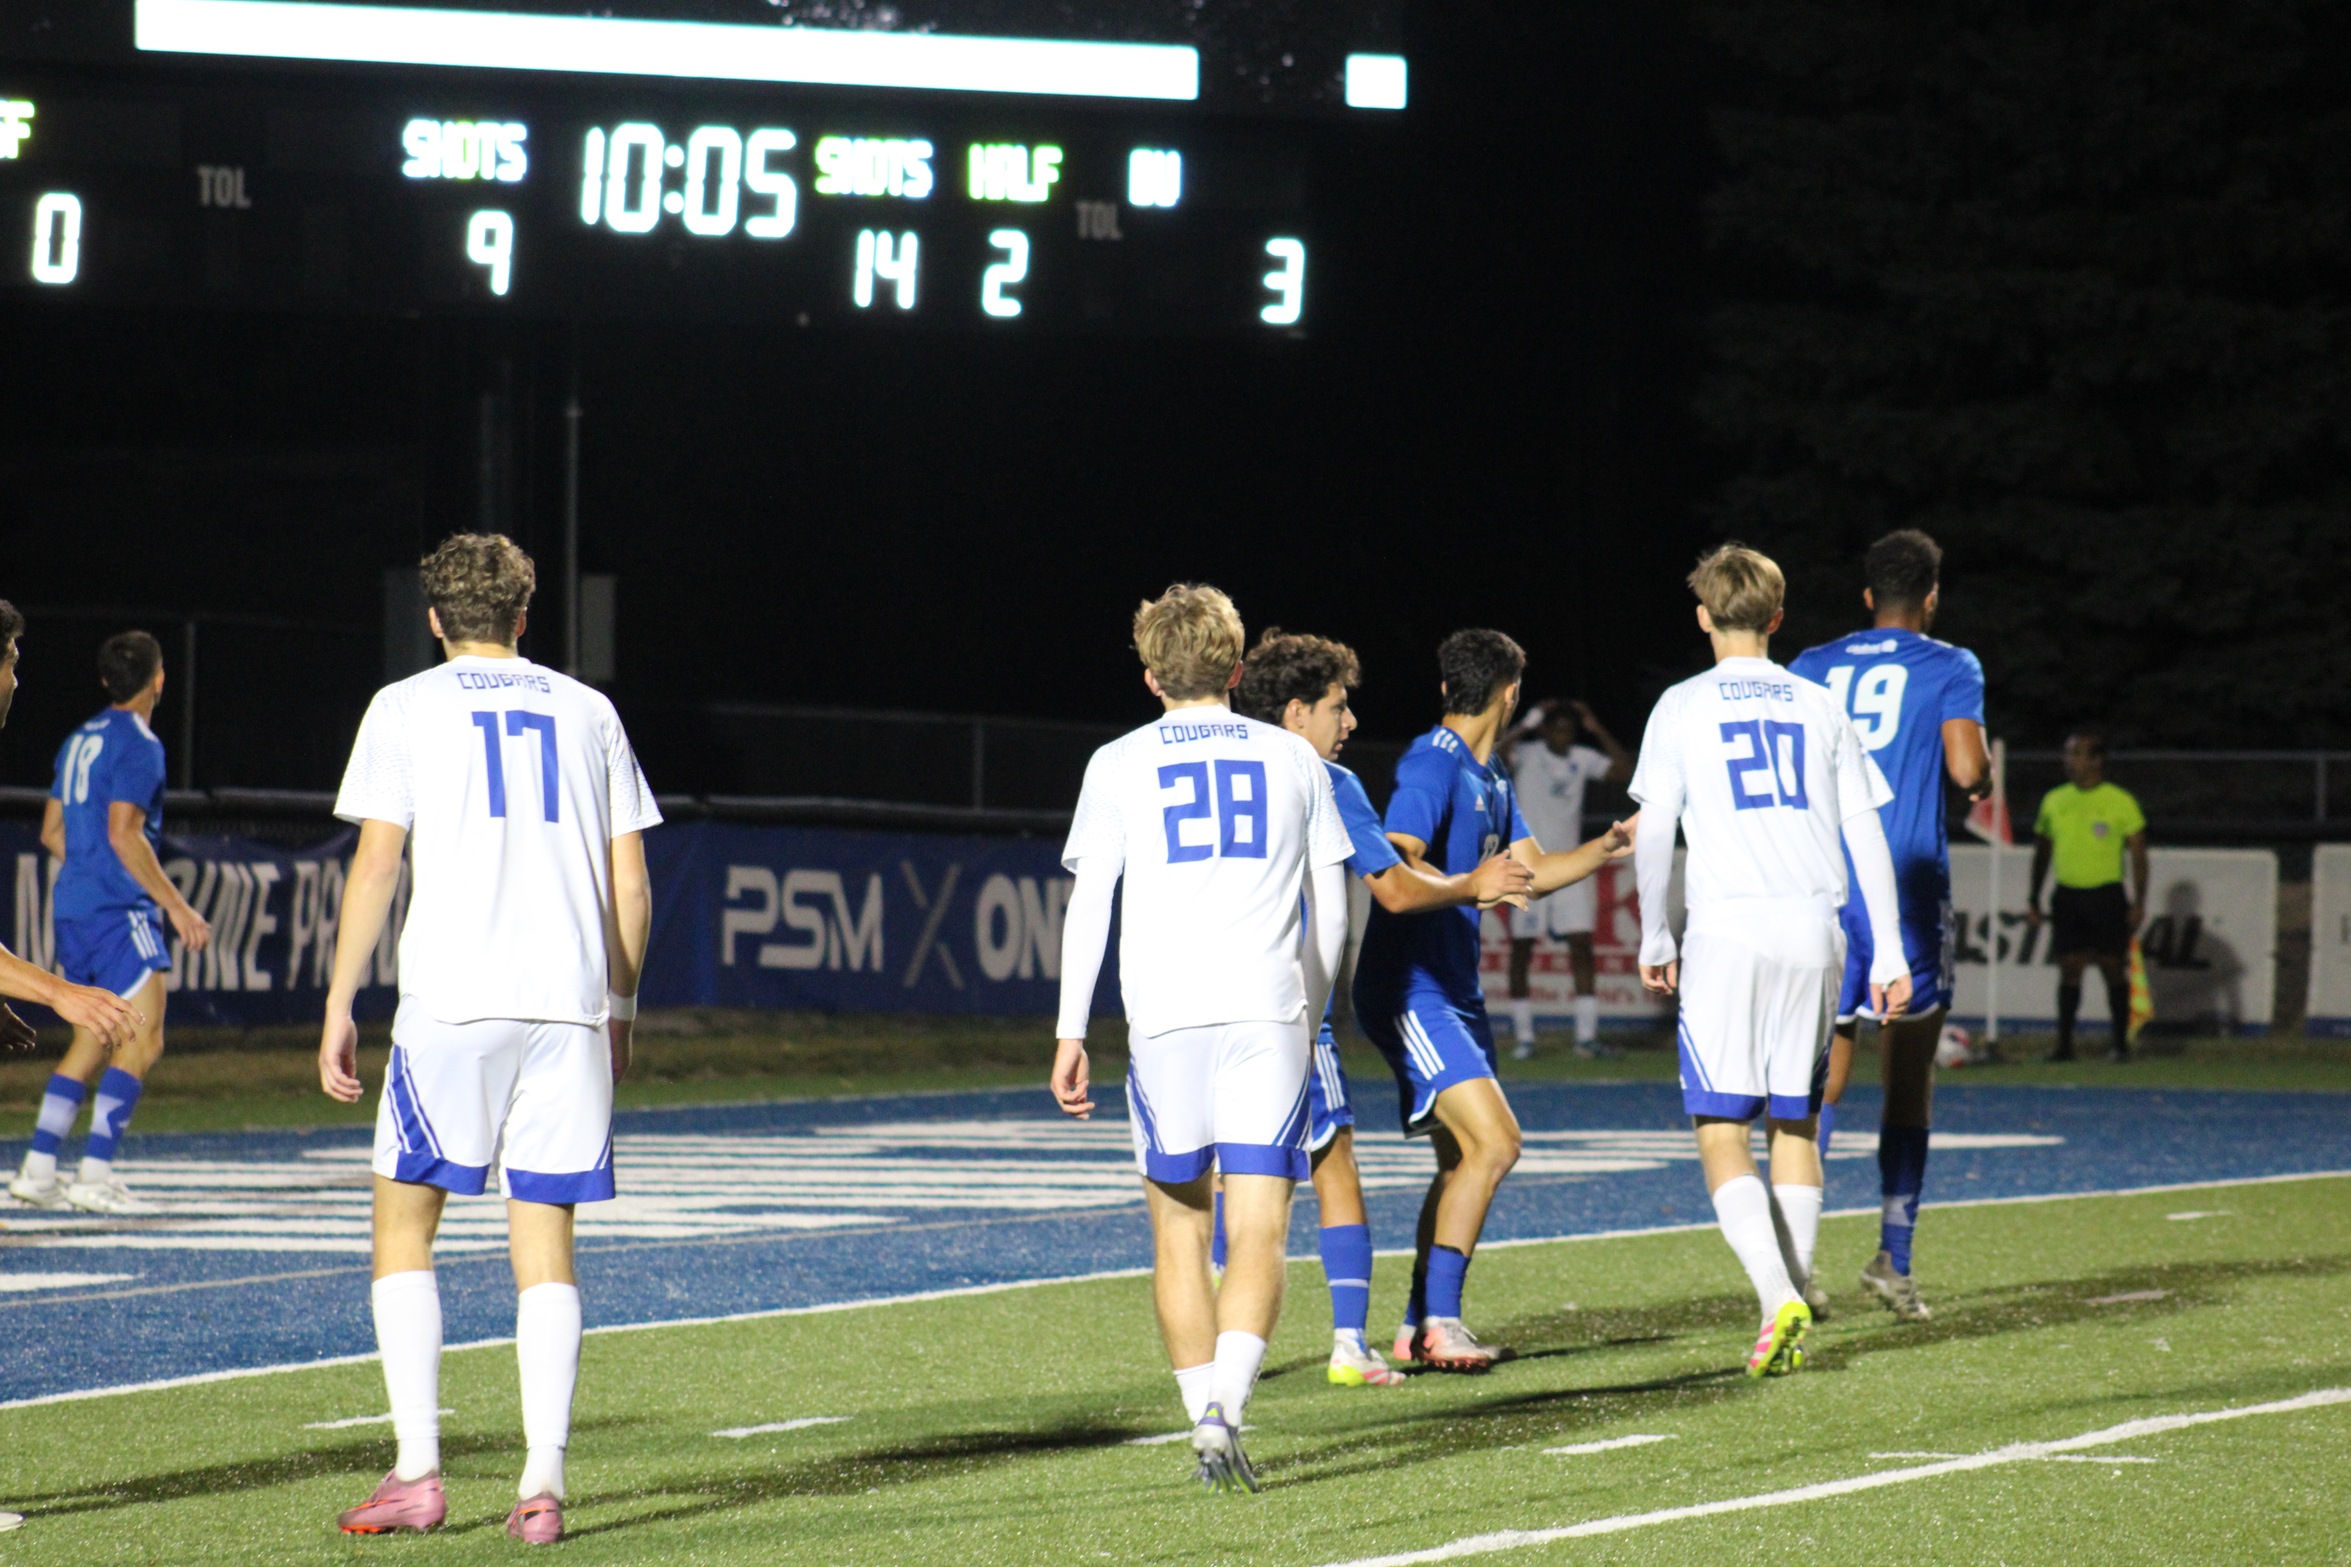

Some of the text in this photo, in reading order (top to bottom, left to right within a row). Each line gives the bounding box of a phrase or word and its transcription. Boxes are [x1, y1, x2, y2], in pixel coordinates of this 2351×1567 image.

[198, 165, 251, 209] TOL
[402, 119, 528, 182] SHOTS
[581, 122, 798, 238] 10:05
[815, 136, 934, 199] SHOTS
[967, 143, 1064, 202] HALF
[32, 192, 82, 284] 0
[467, 211, 514, 296] 9
[854, 229, 919, 310] 14
[981, 229, 1030, 317] 2
[1260, 238, 1306, 325] 3
[456, 672, 552, 694] COUGARS
[1719, 681, 1794, 702] COUGARS
[1824, 664, 1909, 751] 19
[63, 734, 104, 806] 18
[471, 709, 560, 824] 17
[1159, 723, 1249, 745] COUGARS
[1719, 719, 1809, 811] 20
[1157, 759, 1268, 865] 28
[722, 865, 883, 972] PSM
